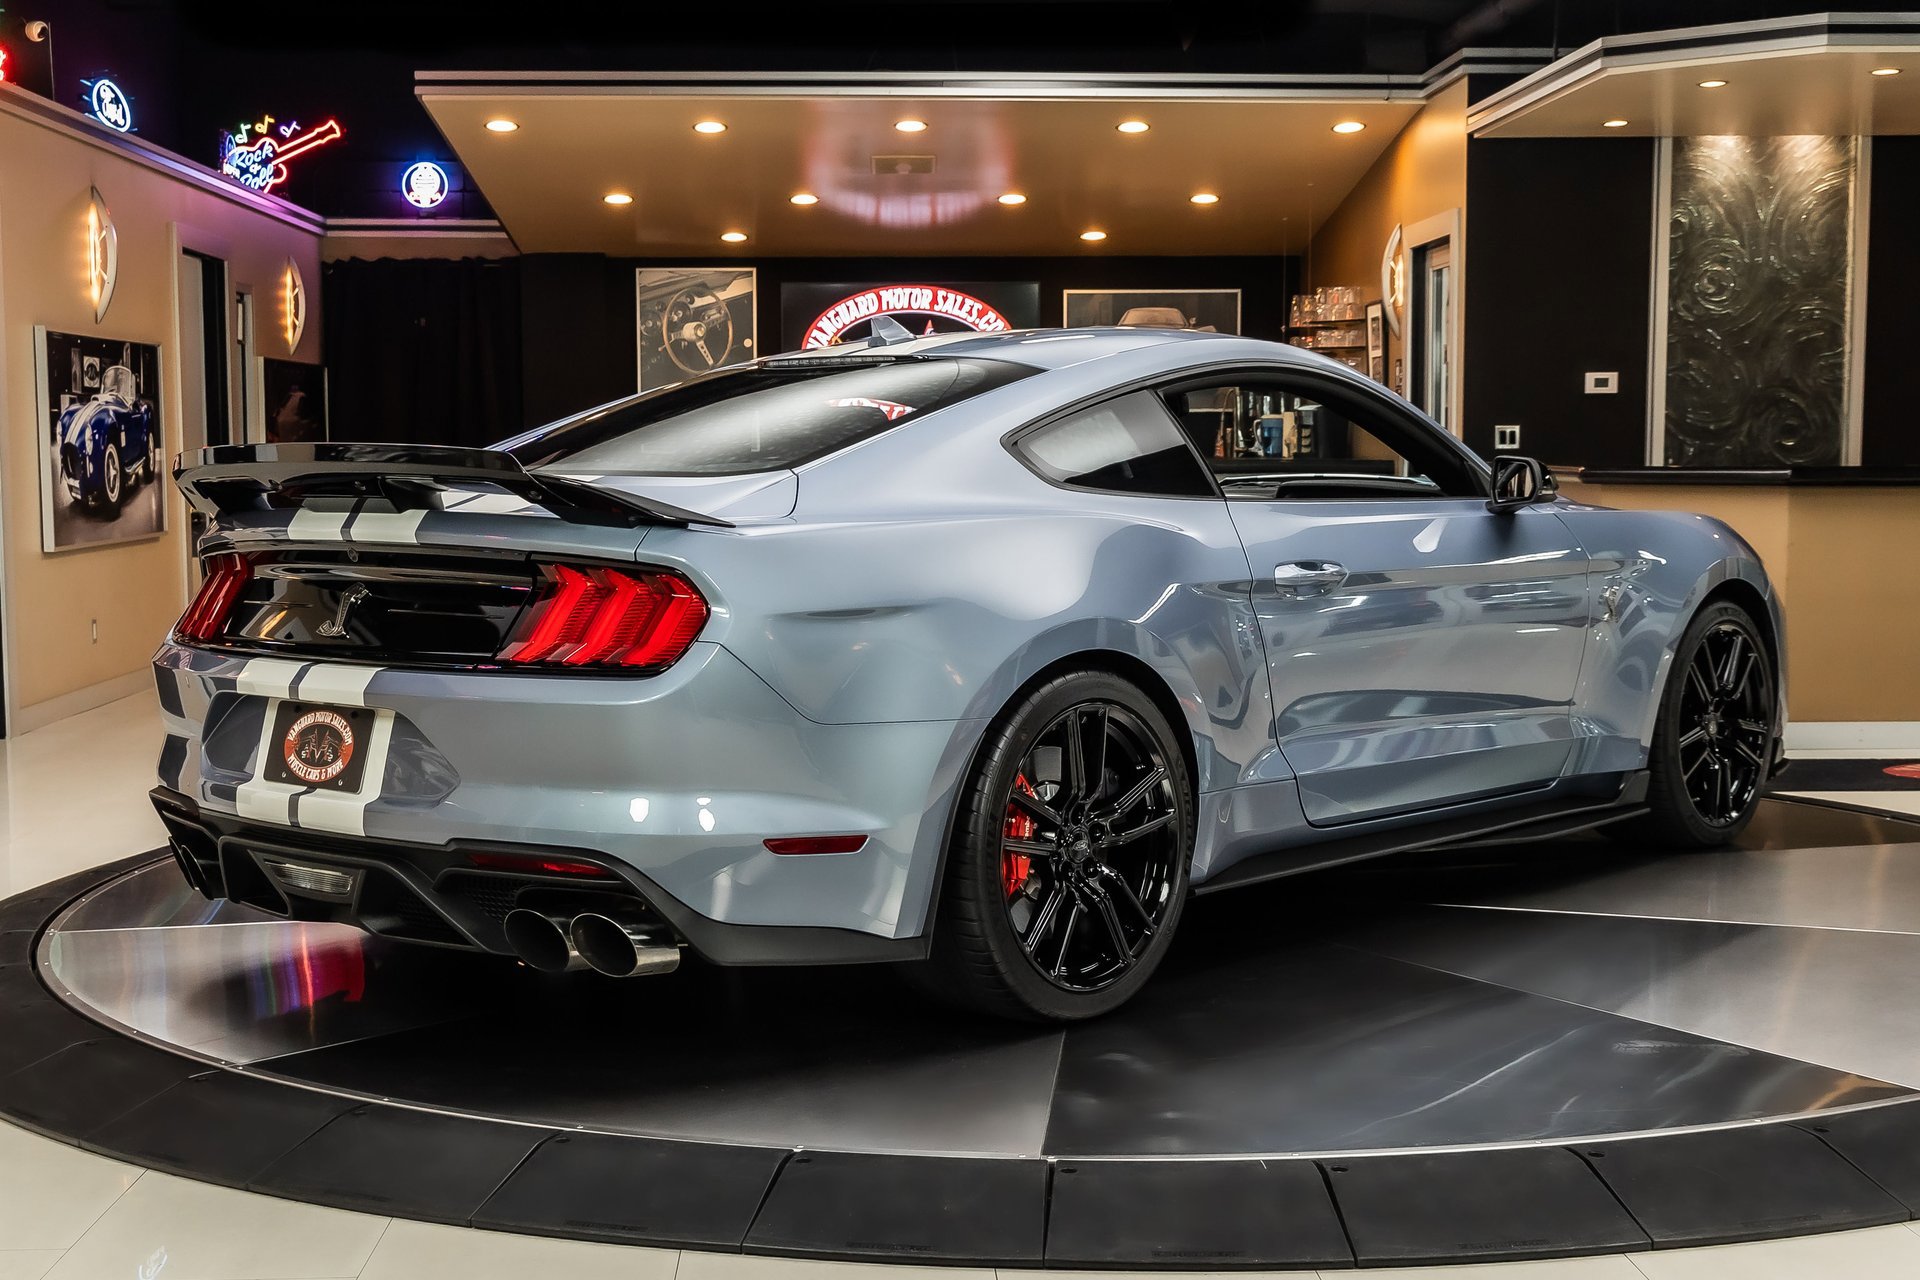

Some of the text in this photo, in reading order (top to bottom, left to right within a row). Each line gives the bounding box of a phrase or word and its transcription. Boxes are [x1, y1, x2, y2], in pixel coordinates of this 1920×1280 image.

[235, 141, 274, 168] Rock
[806, 287, 1007, 350] VANGUARD MOTOR SALES.CO
[287, 712, 316, 741] VANGUARD
[315, 711, 333, 724] MOTOR
[287, 753, 308, 777] MUSCLE
[305, 767, 321, 781] CARS
[327, 758, 344, 778] MORE
